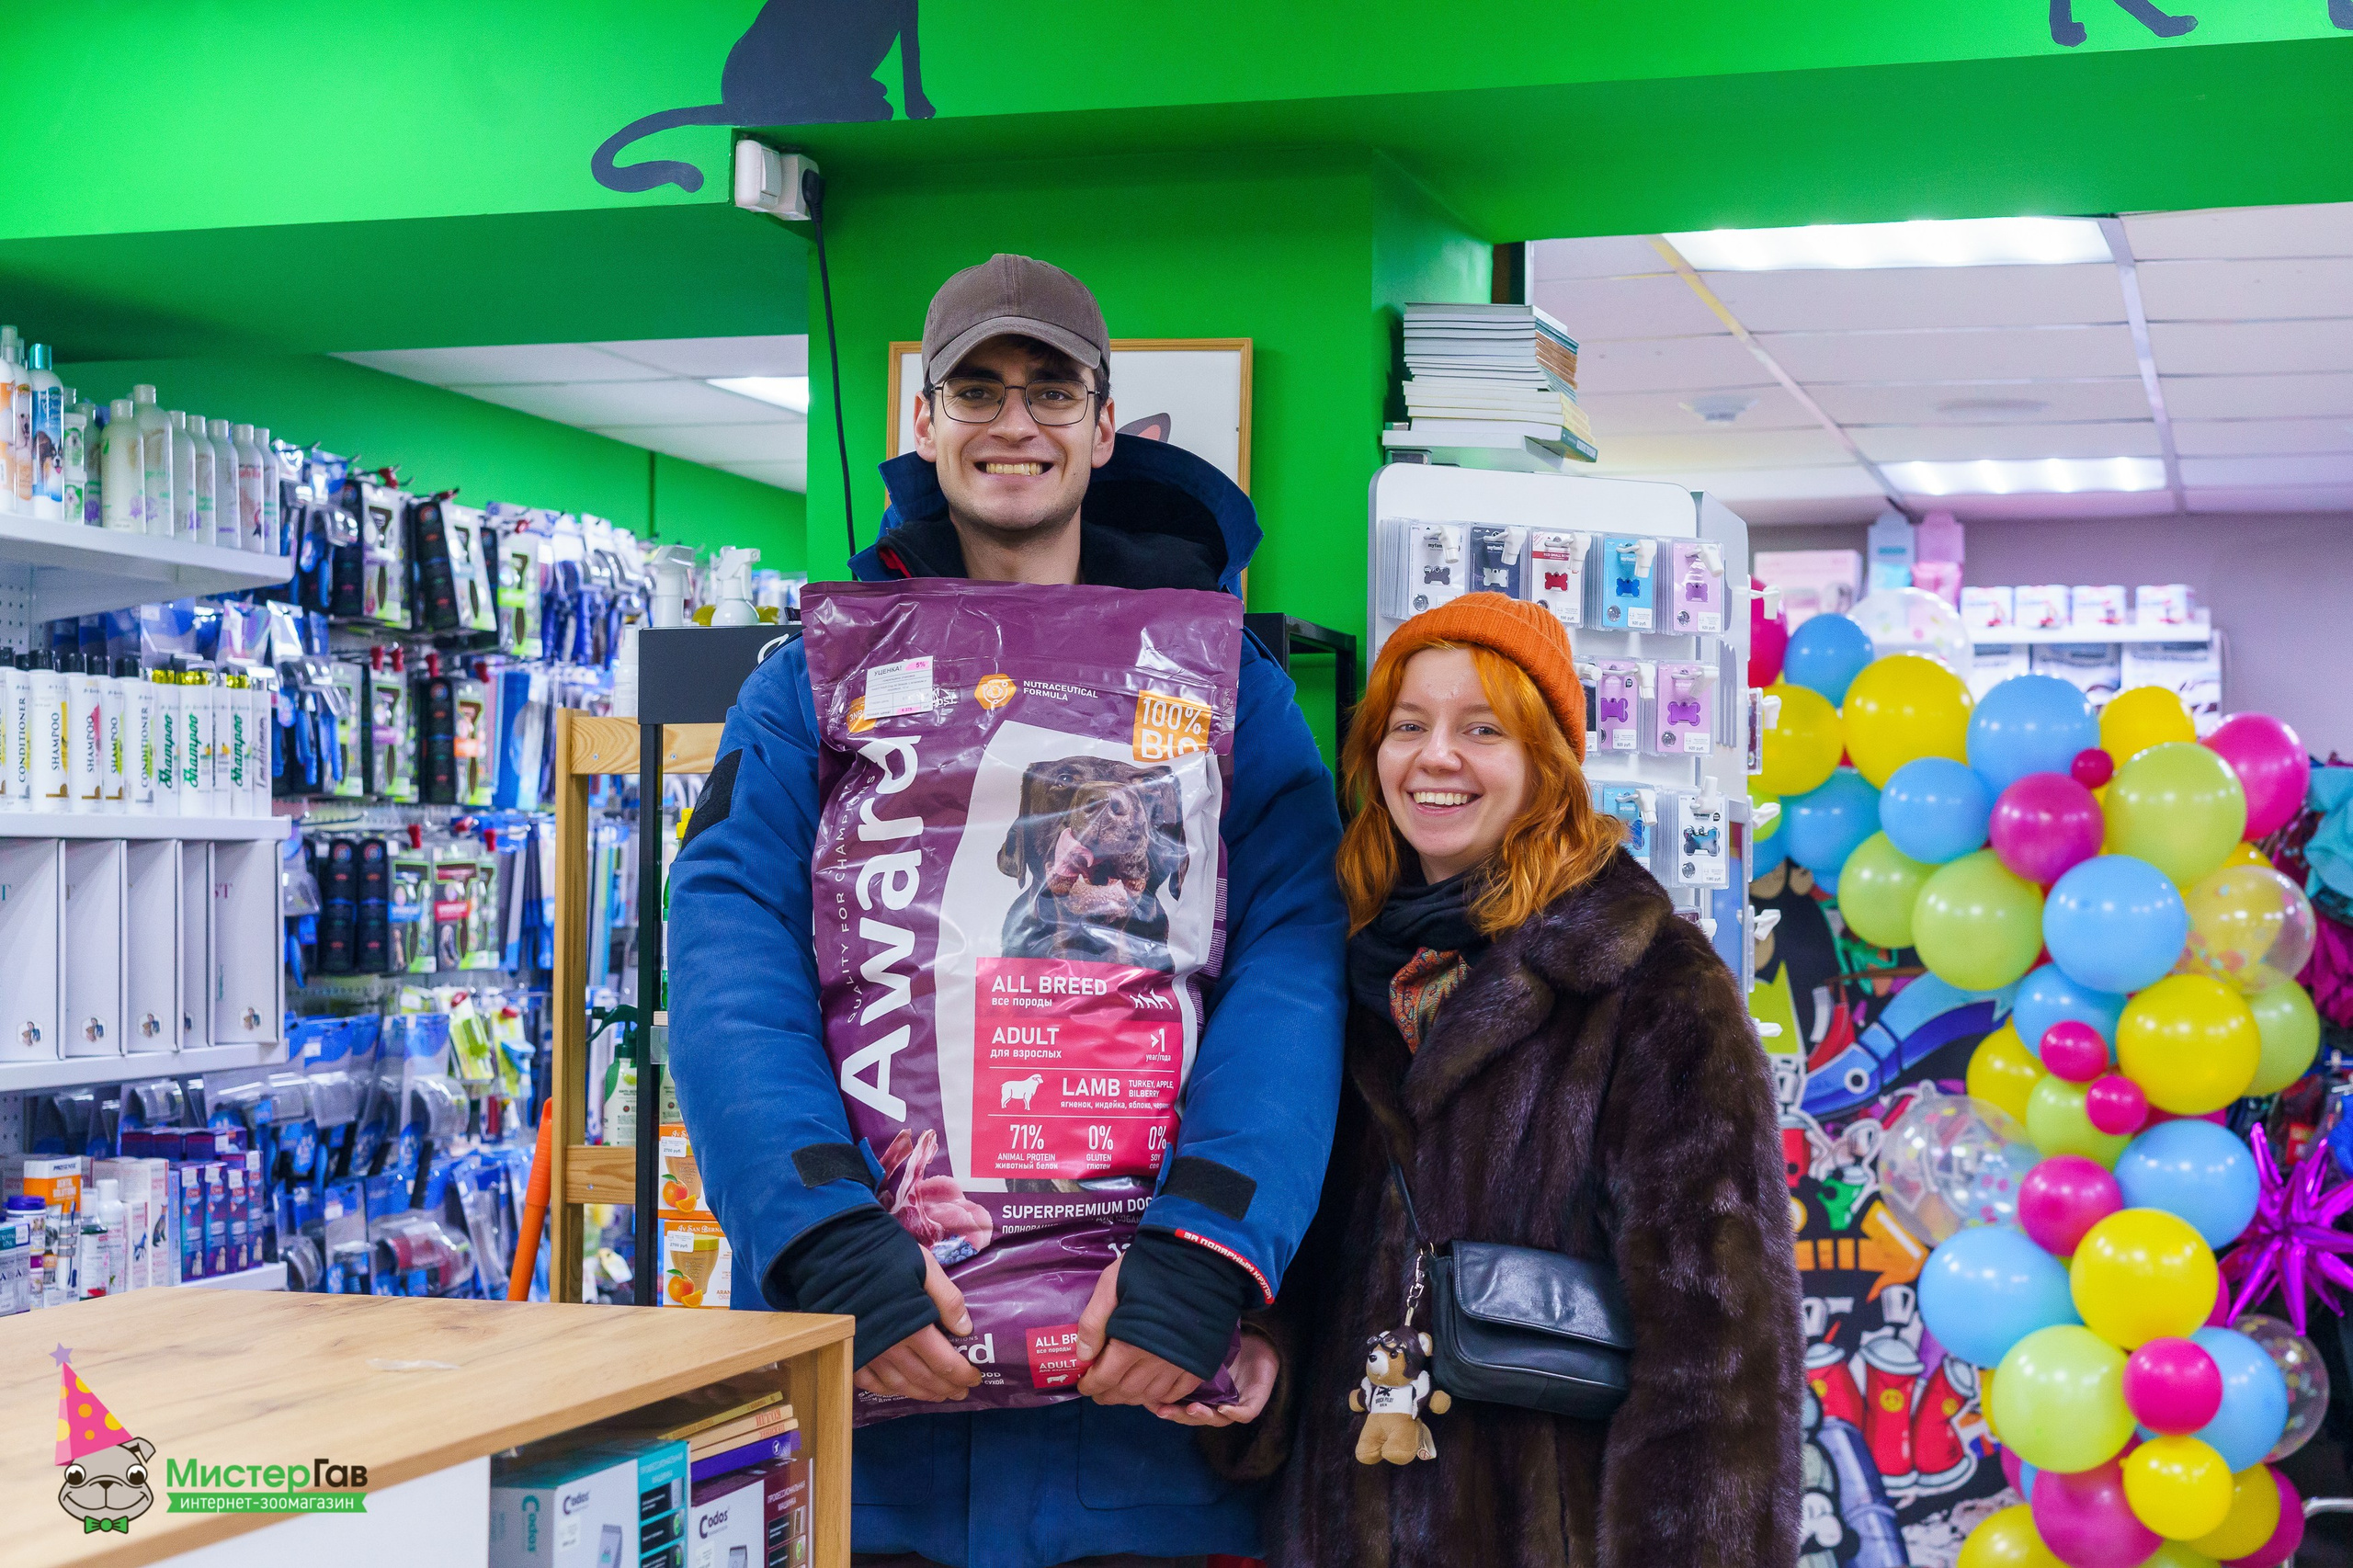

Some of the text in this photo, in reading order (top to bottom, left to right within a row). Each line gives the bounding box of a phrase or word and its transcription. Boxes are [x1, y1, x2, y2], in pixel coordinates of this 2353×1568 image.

[874, 665, 903, 676] УЦЕНКА!
[1023, 680, 1099, 699] NUTRACEUTICAL
[1023, 687, 1069, 701] FORMULA
[1142, 698, 1202, 734] 100%
[17, 697, 26, 782] CONDITIONER
[51, 712, 60, 771] SHAMPOO
[86, 715, 95, 773] SHAMPOO
[230, 713, 244, 787] Shampoo
[1141, 729, 1199, 759] BIO
[158, 712, 174, 789] Shampoo
[184, 712, 201, 789] Shampoo
[835, 775, 876, 1024] QUALITY FOR CHAMPIONS
[840, 735, 925, 1123] Award
[991, 975, 1108, 995] ALL BREED
[991, 998, 1052, 1008] все породы
[991, 1027, 1060, 1045] ADULT
[990, 1050, 1010, 1059] для
[1013, 1050, 1062, 1060] взрослых
[1062, 1078, 1175, 1096] LAMB TURKEY, APPLE,
[1129, 1089, 1160, 1098] BILBERRY
[1060, 1100, 1094, 1109] ягненок,
[1095, 1100, 1128, 1110] индейка,
[1129, 1100, 1152, 1110] яблоко,
[1010, 1124, 1167, 1151] 71% 0% 0%
[995, 1162, 1034, 1170] животный
[1036, 1161, 1059, 1170] белок
[997, 1153, 1161, 1162] ANIMAL PROTEIN GLUTEN SOY
[1002, 1199, 1123, 1220] SUPERPREMIUM
[701, 1225, 723, 1233] BERNA
[1183, 1231, 1273, 1300] ЗА ПОЛЯРНЫМ КРУГОМ
[957, 1333, 995, 1364] rd
[1035, 1333, 1078, 1347] ALL BR
[1040, 1358, 1077, 1369] ADULT
[563, 1491, 591, 1515] Codos
[699, 1508, 730, 1540] Codos
